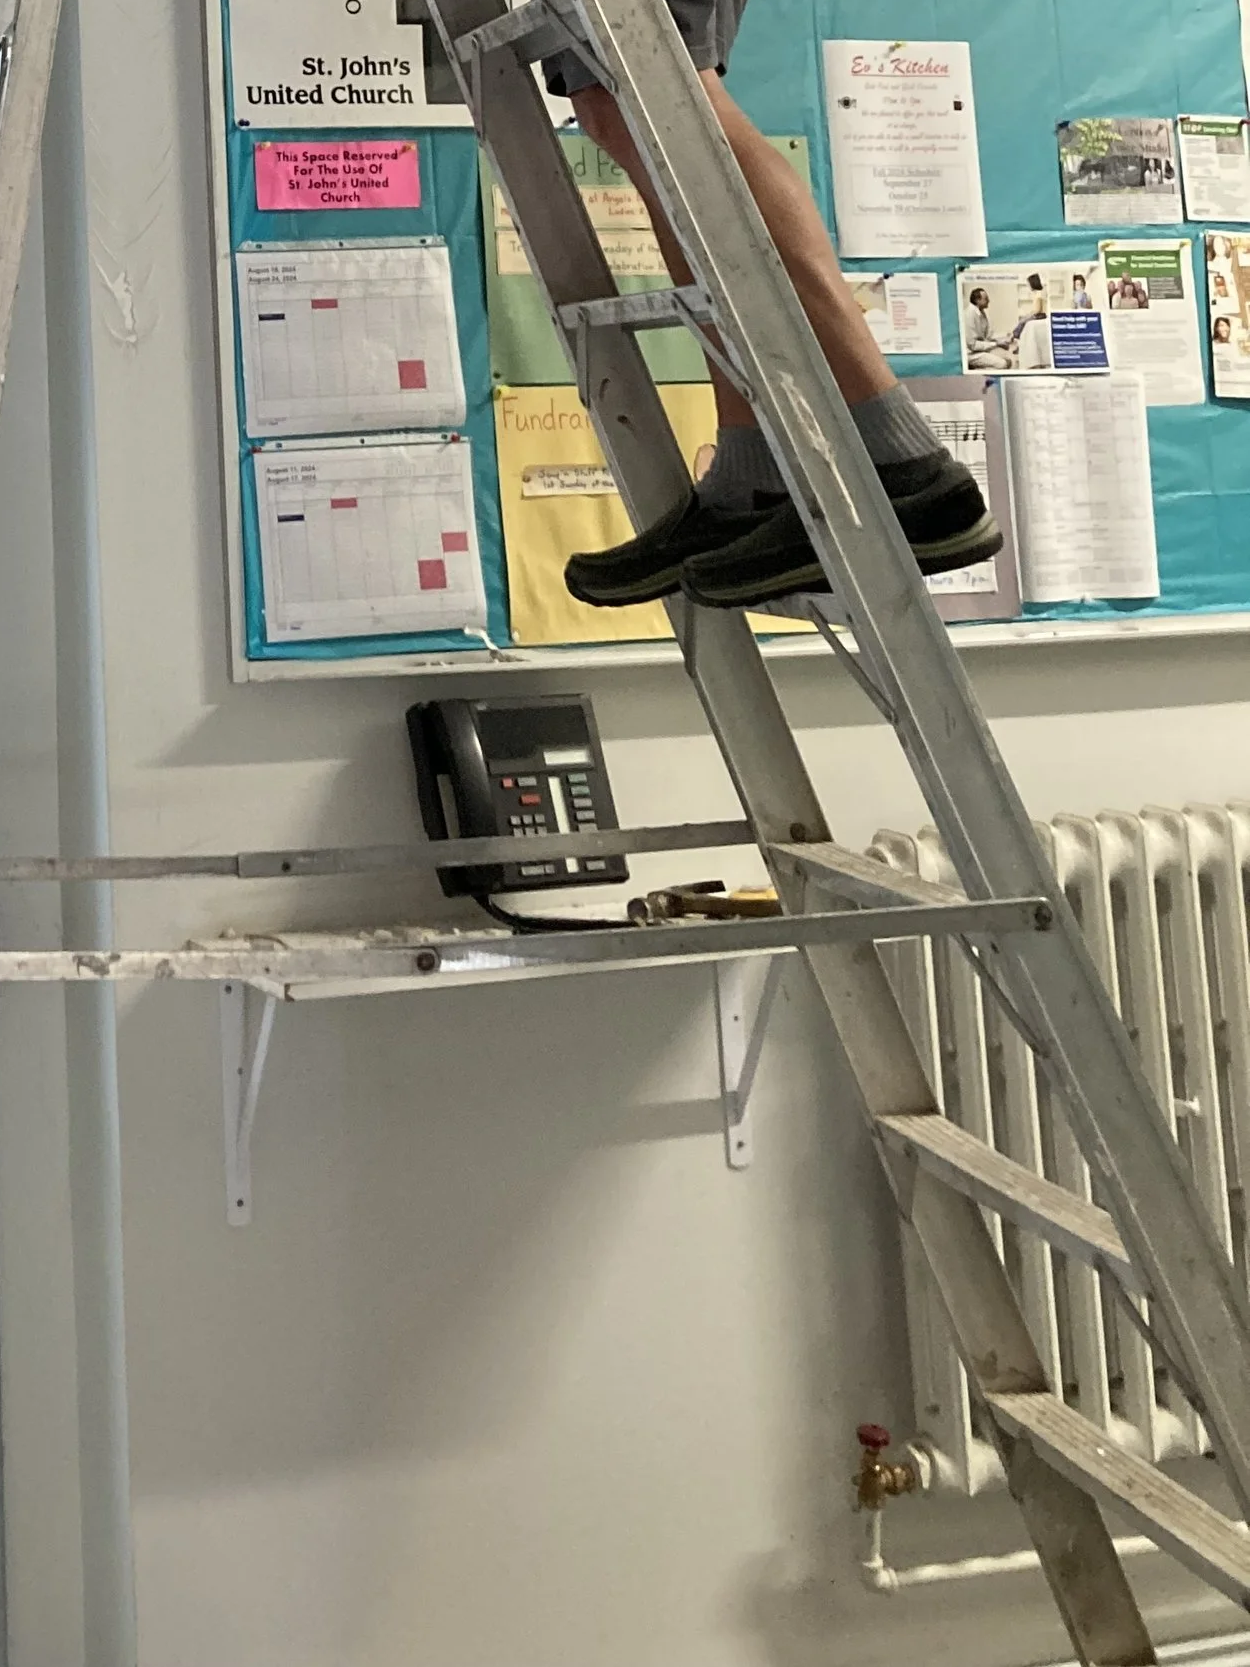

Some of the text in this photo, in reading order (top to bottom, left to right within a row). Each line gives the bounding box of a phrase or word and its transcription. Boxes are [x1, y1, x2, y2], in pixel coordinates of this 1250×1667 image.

[302, 56, 411, 79] St. John's
[890, 57, 950, 74] Kitchen
[246, 84, 414, 105] United Church
[276, 149, 398, 164] This Space Reserved
[293, 163, 383, 176] For The Use Of
[307, 179, 347, 189] John's
[350, 178, 389, 189] United
[320, 191, 361, 203] Church
